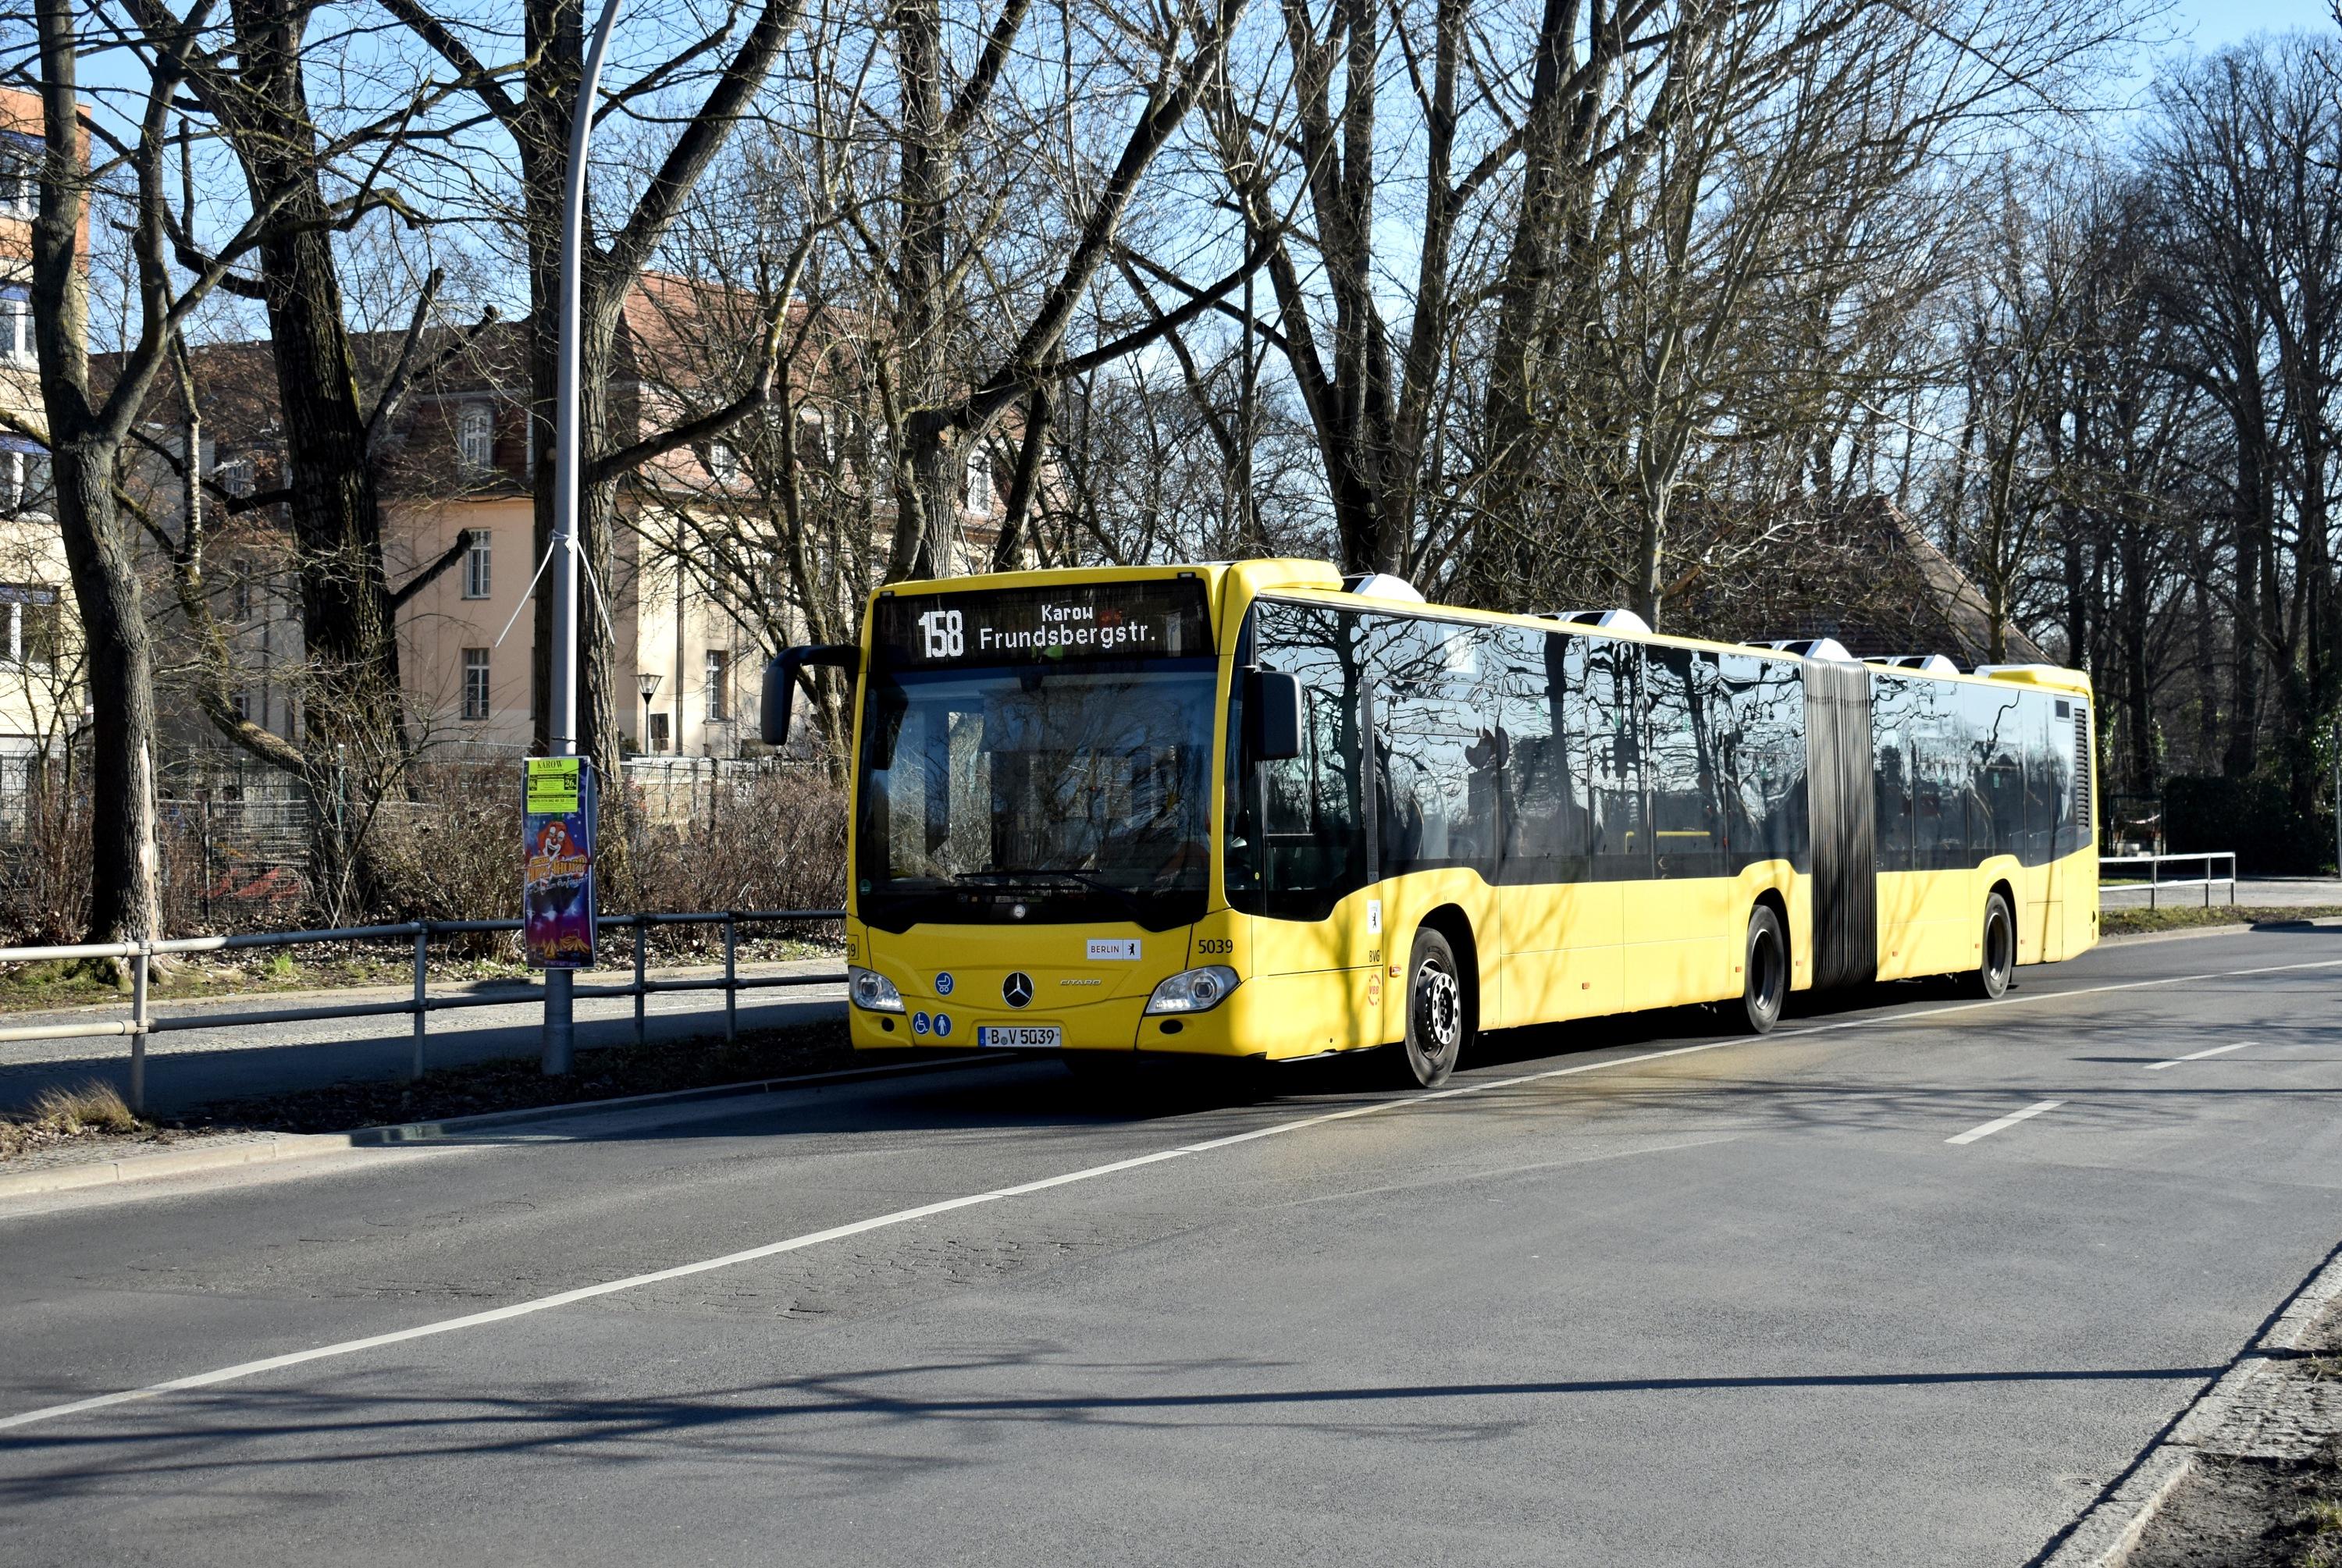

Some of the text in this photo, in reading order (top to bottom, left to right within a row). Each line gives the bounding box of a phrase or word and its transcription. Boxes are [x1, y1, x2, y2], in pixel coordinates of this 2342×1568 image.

[1041, 604, 1093, 622] Karow
[918, 610, 963, 659] 158
[980, 621, 1155, 649] Frundsbergstr.
[537, 759, 563, 769] KAROW
[1091, 945, 1119, 954] BERLIN
[1198, 939, 1233, 955] 5039
[1369, 949, 1380, 962] BVG
[1369, 986, 1379, 995] VBB
[991, 1029, 1055, 1044] B V 5039
